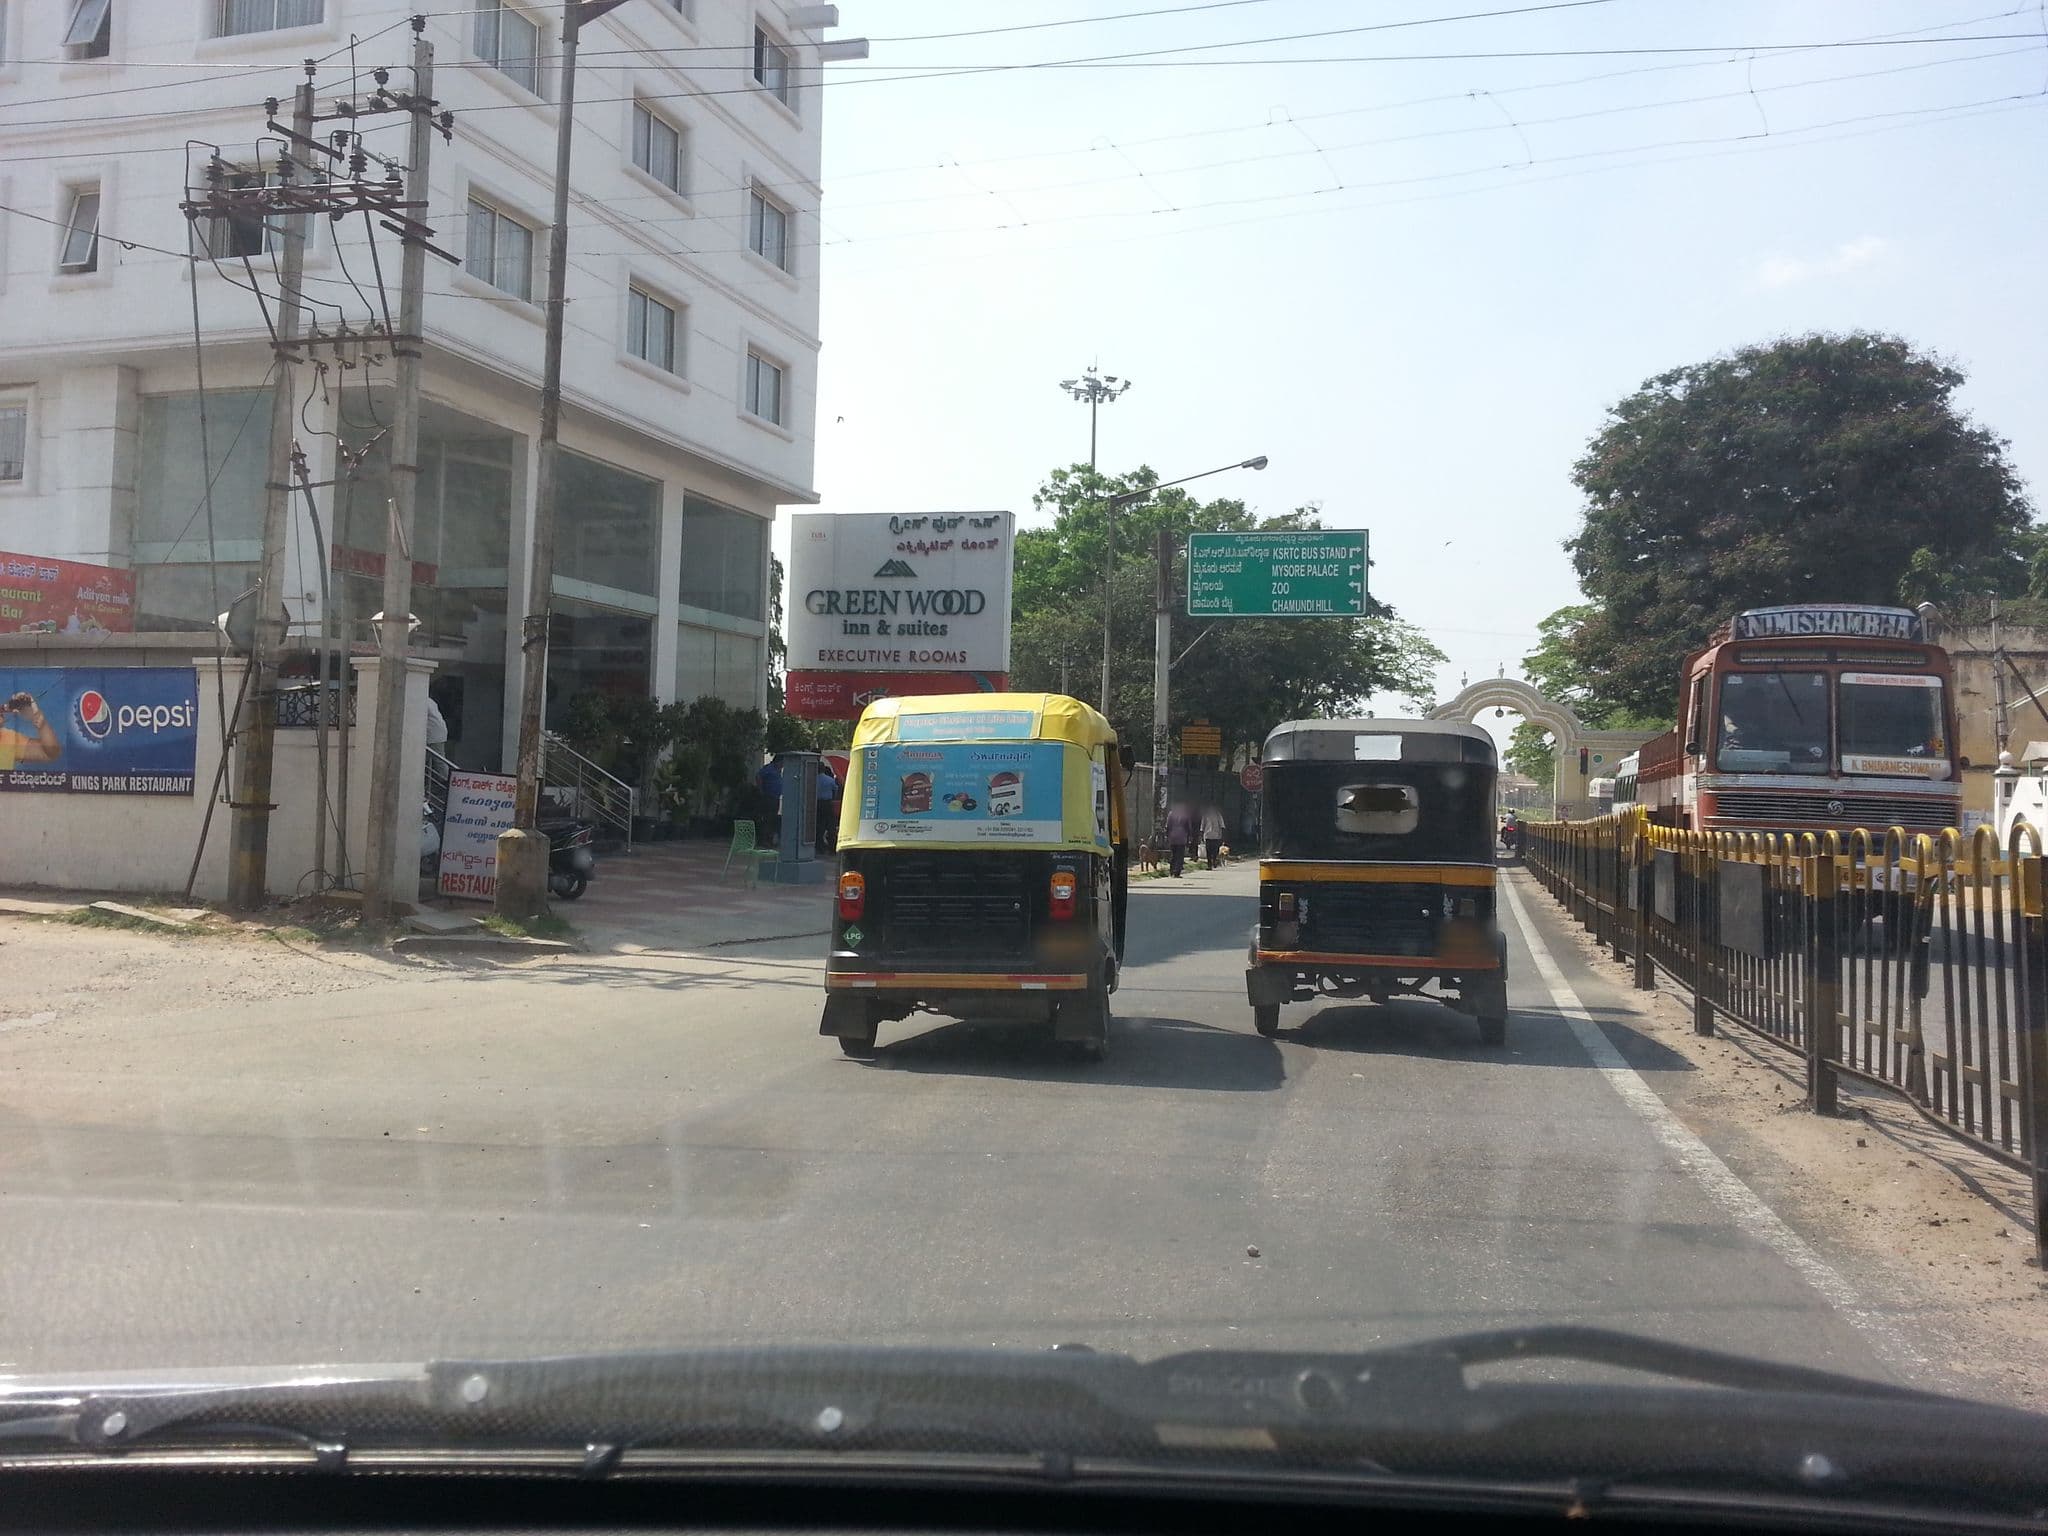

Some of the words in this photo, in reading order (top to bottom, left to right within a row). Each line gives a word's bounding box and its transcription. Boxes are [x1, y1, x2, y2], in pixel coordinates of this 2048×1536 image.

[1272, 547, 1300, 561] KSRTC
[1301, 547, 1319, 560] BUS
[1319, 547, 1347, 560] STAND
[1272, 564, 1306, 577] MYSORE
[1306, 564, 1339, 577] PALACE
[1271, 582, 1290, 595] ZOO
[1272, 600, 1315, 613] CHAMUNDI
[1315, 599, 1334, 612] HILL
[842, 619, 870, 636] inn
[876, 620, 892, 636] &
[896, 620, 949, 637] suites
[818, 649, 900, 664] EXECUTIVE
[908, 650, 968, 664] ROOMS
[118, 699, 192, 734] pepsi
[71, 775, 100, 790] KINGS
[102, 775, 128, 791] PARK
[130, 776, 192, 792] RESTAURANT
[442, 851, 483, 870] Kings
[441, 872, 496, 896] RESTAU
[845, 932, 861, 941] LPG
